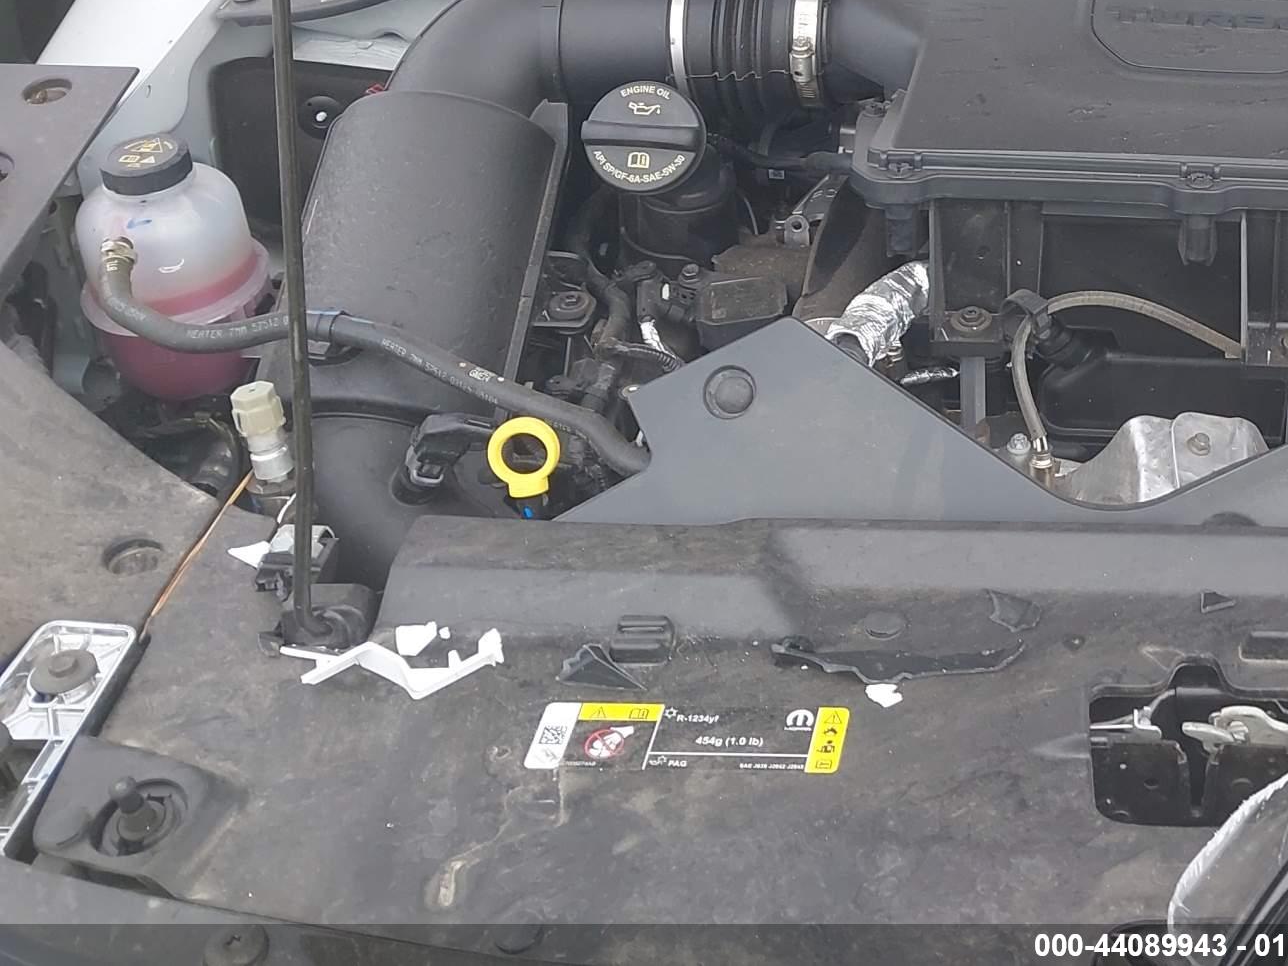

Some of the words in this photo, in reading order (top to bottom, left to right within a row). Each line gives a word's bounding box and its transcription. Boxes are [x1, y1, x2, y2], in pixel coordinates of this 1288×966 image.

[620, 86, 656, 98] ENGINE
[656, 88, 671, 100] OIL
[593, 150, 606, 167] API
[695, 736, 723, 747] 454g
[725, 736, 745, 747] (1.0
[748, 737, 764, 747] lb)
[668, 760, 688, 768] PAG
